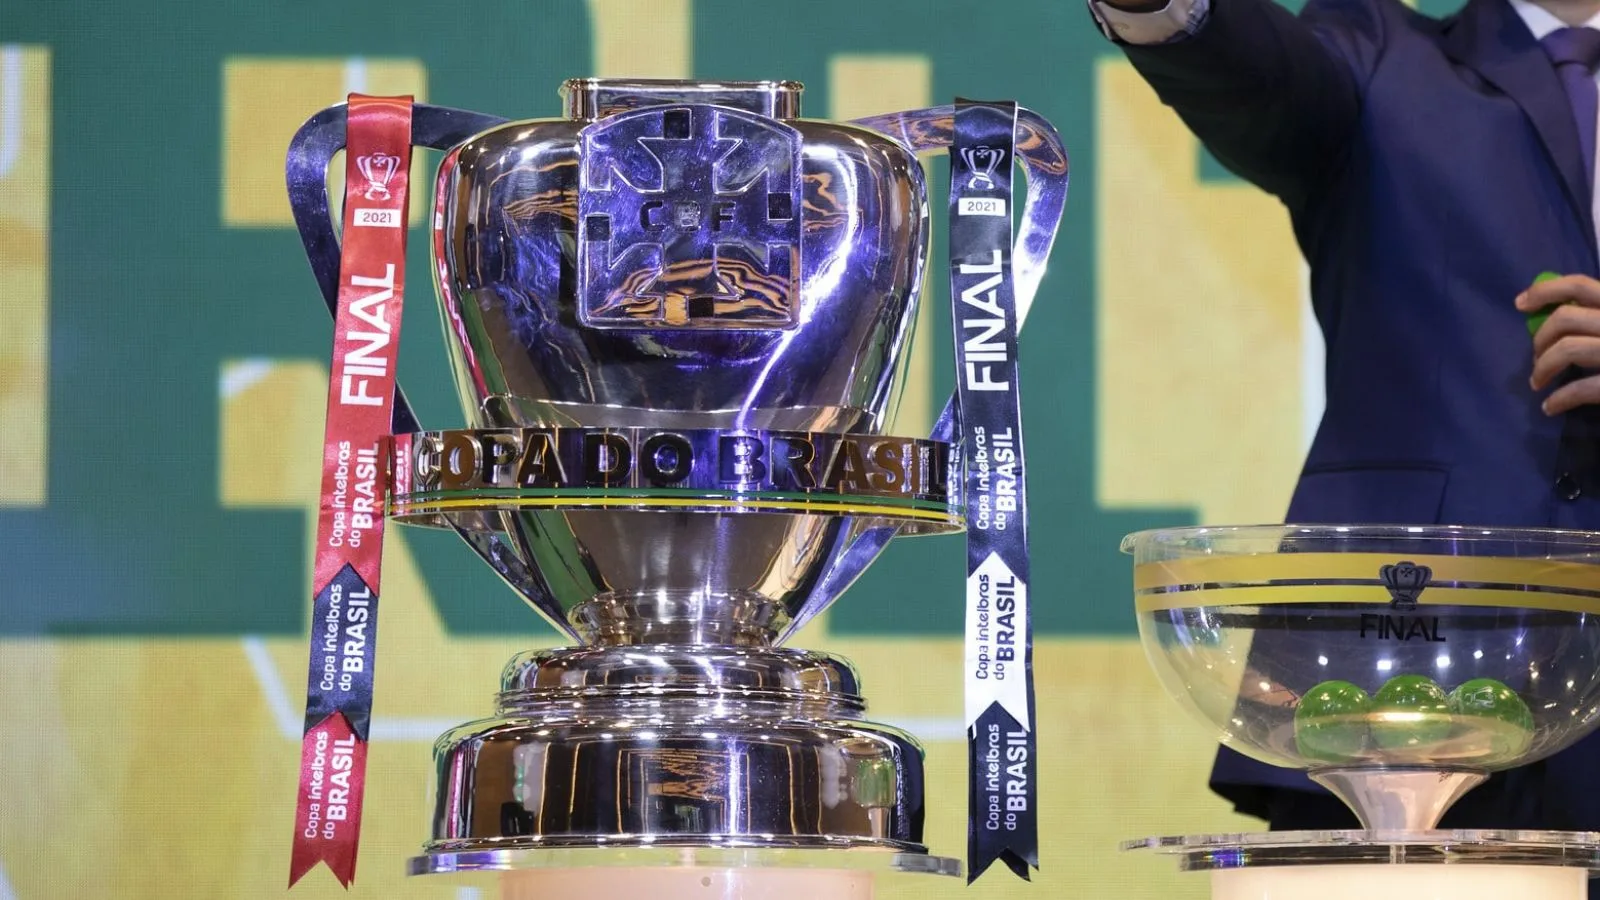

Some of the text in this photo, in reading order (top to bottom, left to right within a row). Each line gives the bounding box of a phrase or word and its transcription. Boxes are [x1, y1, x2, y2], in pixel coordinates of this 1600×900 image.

[362, 212, 392, 223] 2021
[967, 201, 996, 212] 2021
[340, 263, 396, 406] FINAL
[960, 249, 1010, 392] FINAL
[329, 441, 351, 547] Copa intelbras
[348, 442, 379, 548] do BRASIL
[413, 432, 568, 486] COPA
[583, 431, 695, 487] DO
[717, 434, 948, 497] BRASIL
[974, 426, 991, 529] Copa intelbras
[992, 427, 1017, 530] do BRASIL
[320, 584, 342, 690] Copa intelbras
[338, 586, 370, 691] do BRASIL
[976, 574, 991, 679] Copa intelbras
[993, 575, 1015, 680] do BRASIL
[1360, 613, 1446, 642] FINAL
[305, 731, 328, 838] Copa intelbras
[322, 733, 355, 839] do BRASIL
[986, 724, 1002, 830] Copa intelbras
[1004, 728, 1028, 831] do BRASIL
